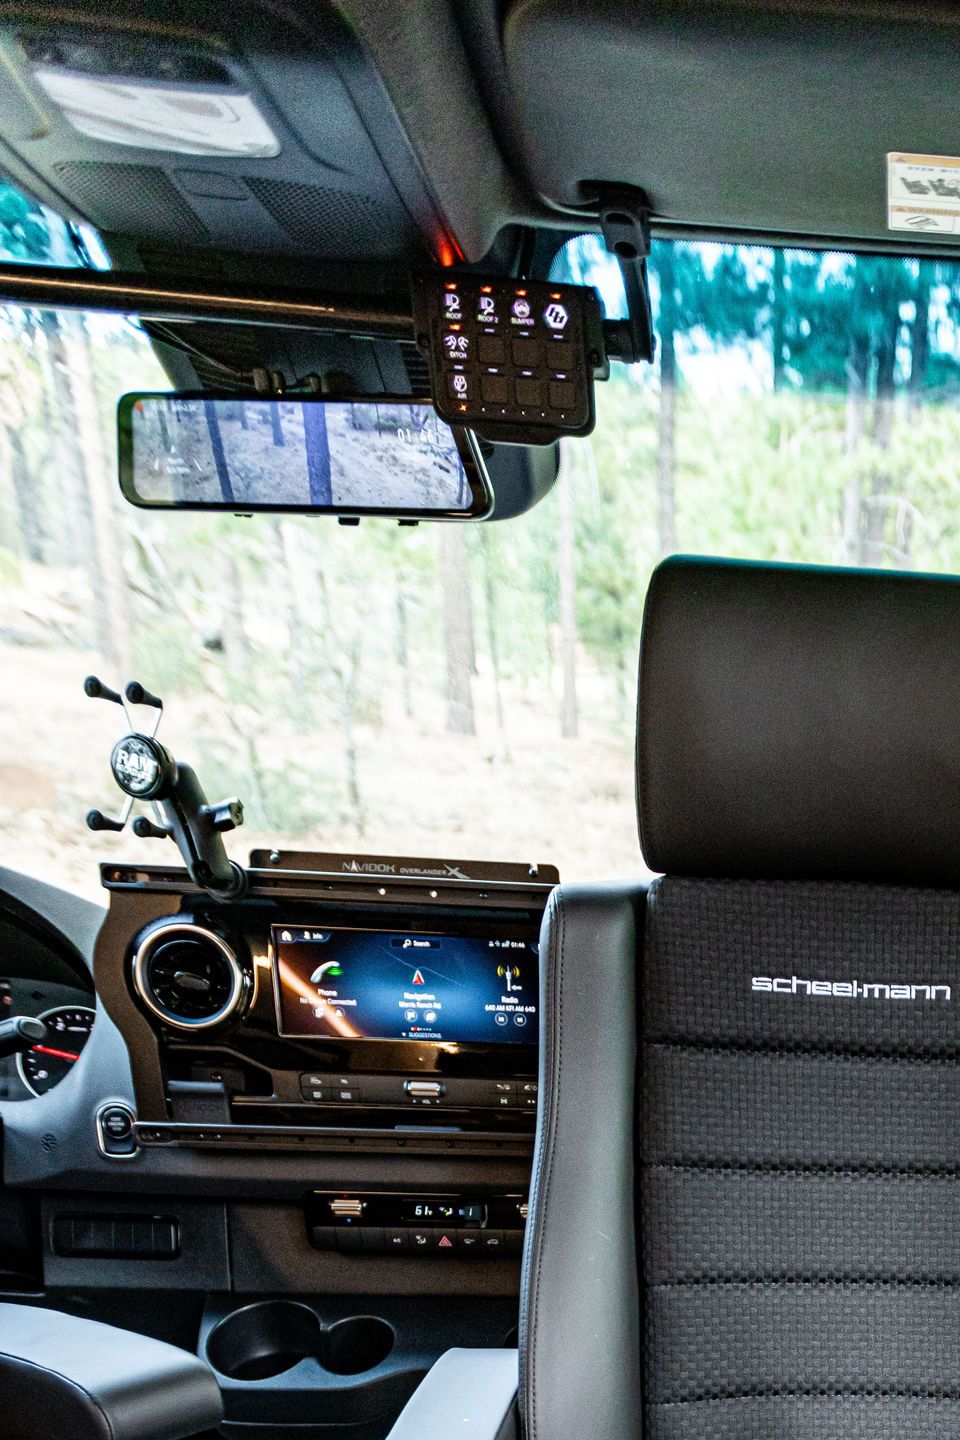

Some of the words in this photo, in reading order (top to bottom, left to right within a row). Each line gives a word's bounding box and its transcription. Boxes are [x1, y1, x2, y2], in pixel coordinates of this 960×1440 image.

[446, 312, 462, 320] ROOF
[478, 313, 495, 323] ROOF
[511, 316, 535, 326] BUMPER
[449, 350, 467, 359] DITCH
[457, 392, 467, 400] AIR
[399, 867, 447, 876] OVERLANDER
[413, 939, 431, 948] Search
[317, 988, 338, 997] Phone
[403, 991, 436, 1002] Navigation
[326, 997, 358, 1007] Connected
[501, 995, 519, 1004] Radio
[408, 1031, 442, 1040] SUGGESTIONS
